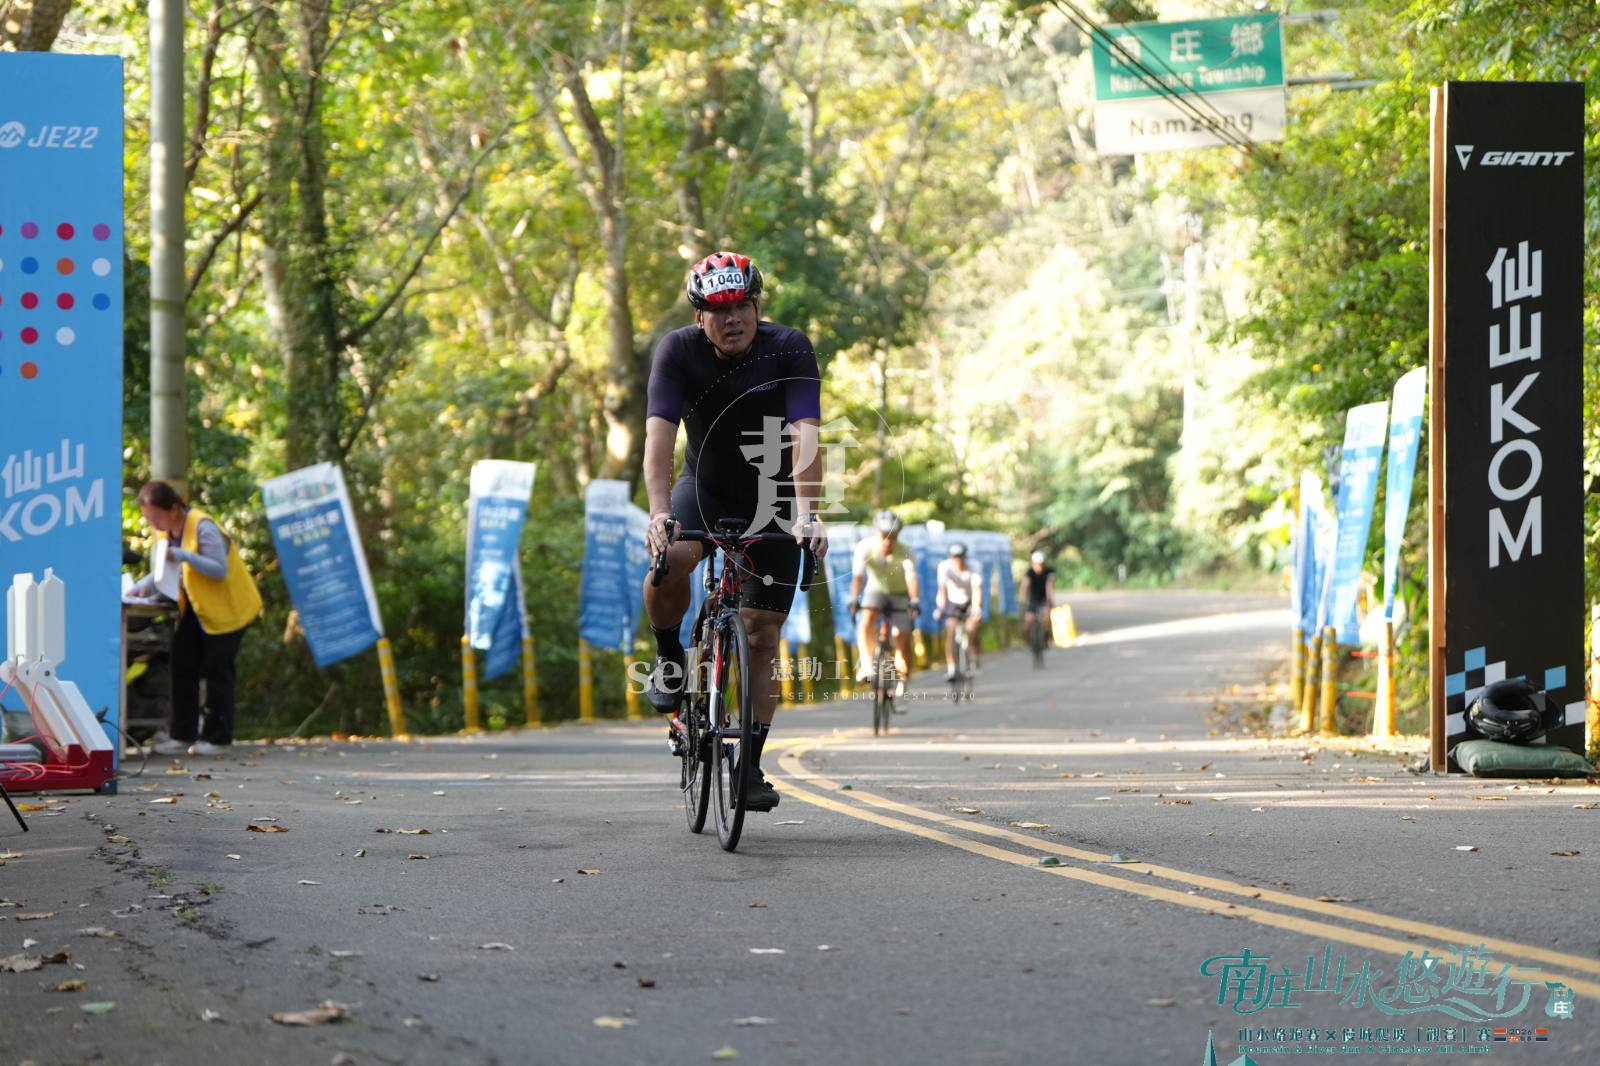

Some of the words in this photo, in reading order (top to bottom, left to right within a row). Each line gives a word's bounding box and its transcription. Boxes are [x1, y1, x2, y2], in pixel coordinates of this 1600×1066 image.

[1197, 64, 1266, 85] Township
[27, 125, 99, 149] JE22
[1479, 151, 1576, 167] GIANT
[0, 438, 85, 499] 仙山
